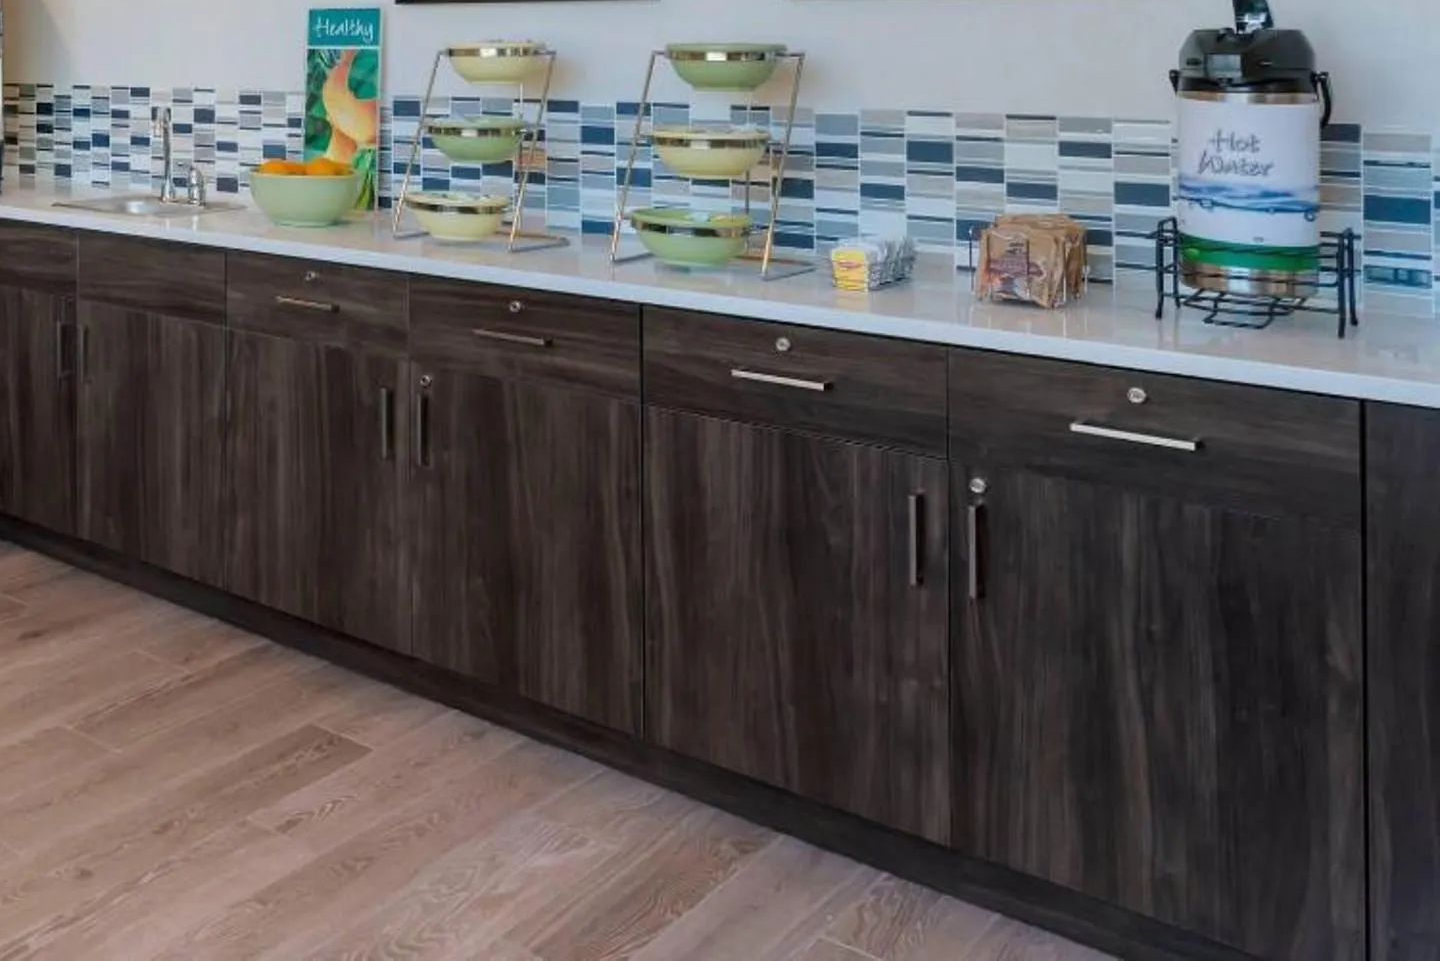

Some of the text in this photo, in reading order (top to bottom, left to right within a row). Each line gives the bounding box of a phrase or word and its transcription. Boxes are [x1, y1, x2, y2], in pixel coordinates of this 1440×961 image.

[313, 16, 373, 43] Healthy
[1208, 129, 1262, 152] Hot
[1197, 150, 1274, 176] Water
